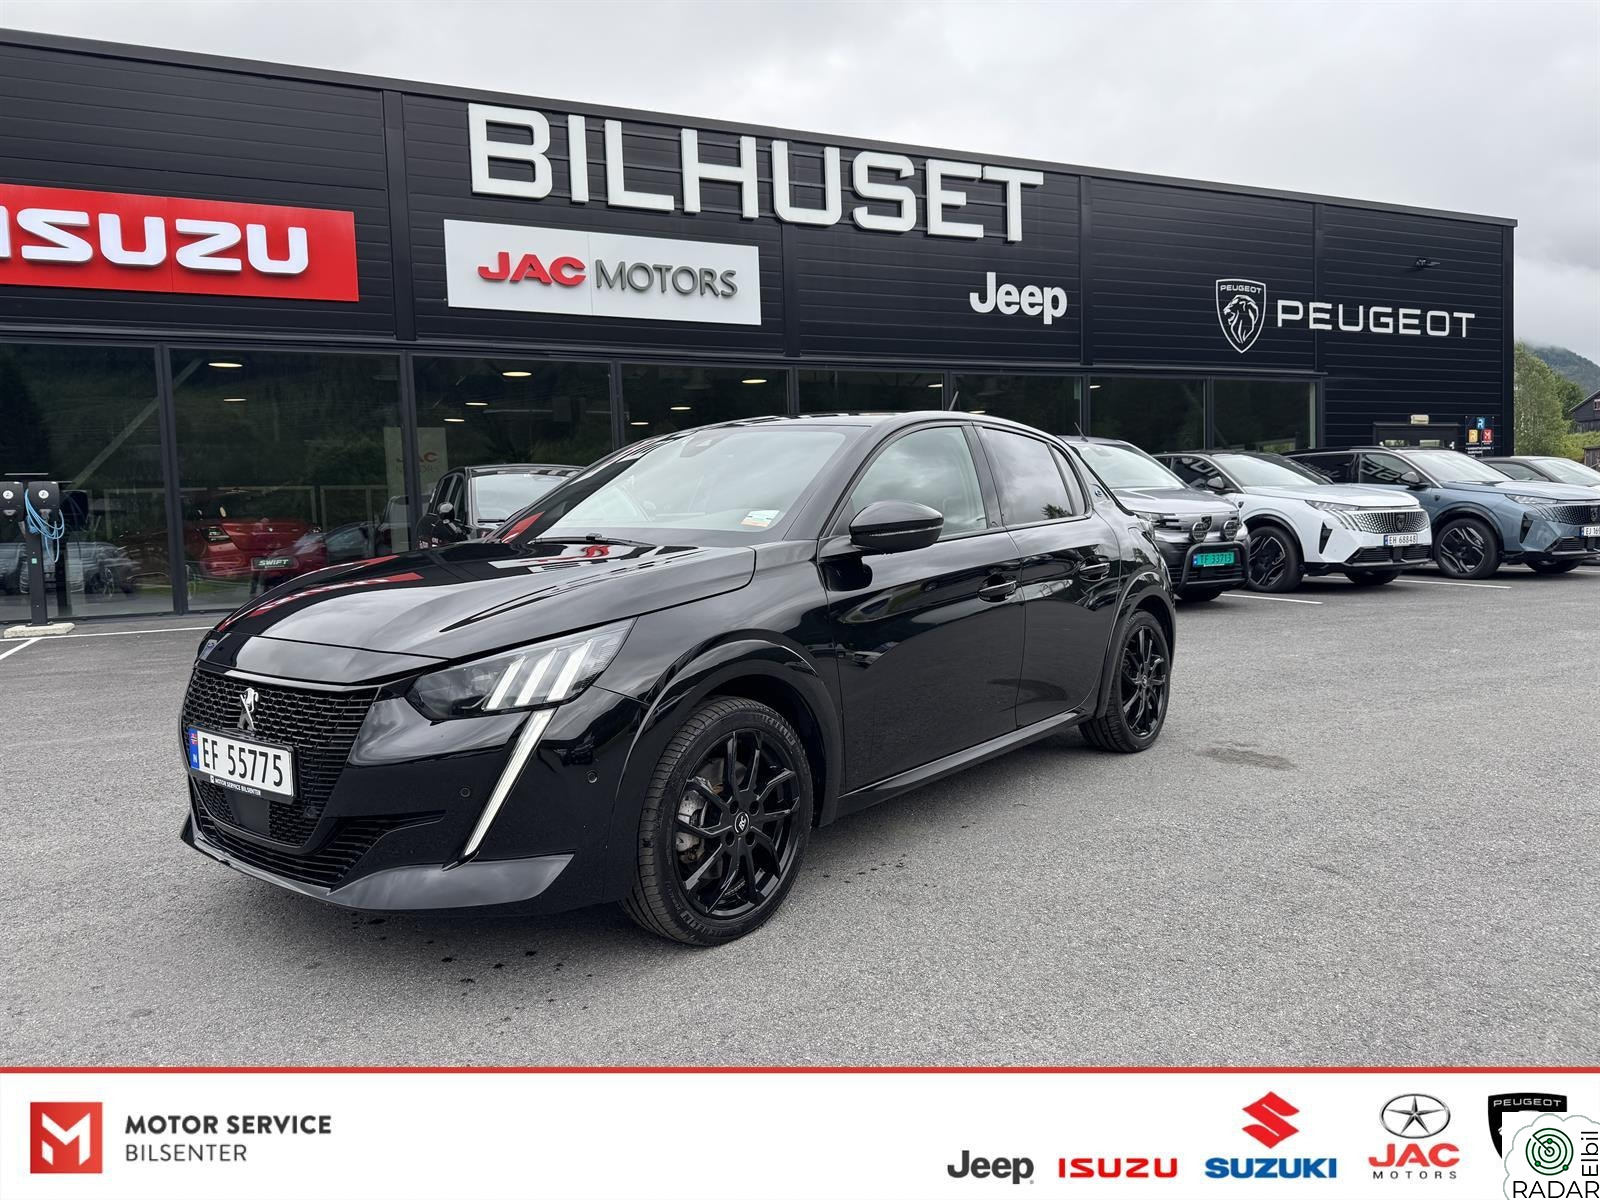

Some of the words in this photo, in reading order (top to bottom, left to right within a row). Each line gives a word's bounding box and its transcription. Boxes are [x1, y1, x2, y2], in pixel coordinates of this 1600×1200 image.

[468, 102, 1044, 242] BILHUSET
[478, 251, 586, 287] JAC
[594, 259, 738, 299] MOTORS
[970, 272, 1067, 324] Jeep
[1219, 283, 1262, 294] PEUGEOT
[1278, 300, 1475, 338] PEUGEOT
[202, 737, 219, 770] EF
[227, 744, 283, 787] 55775
